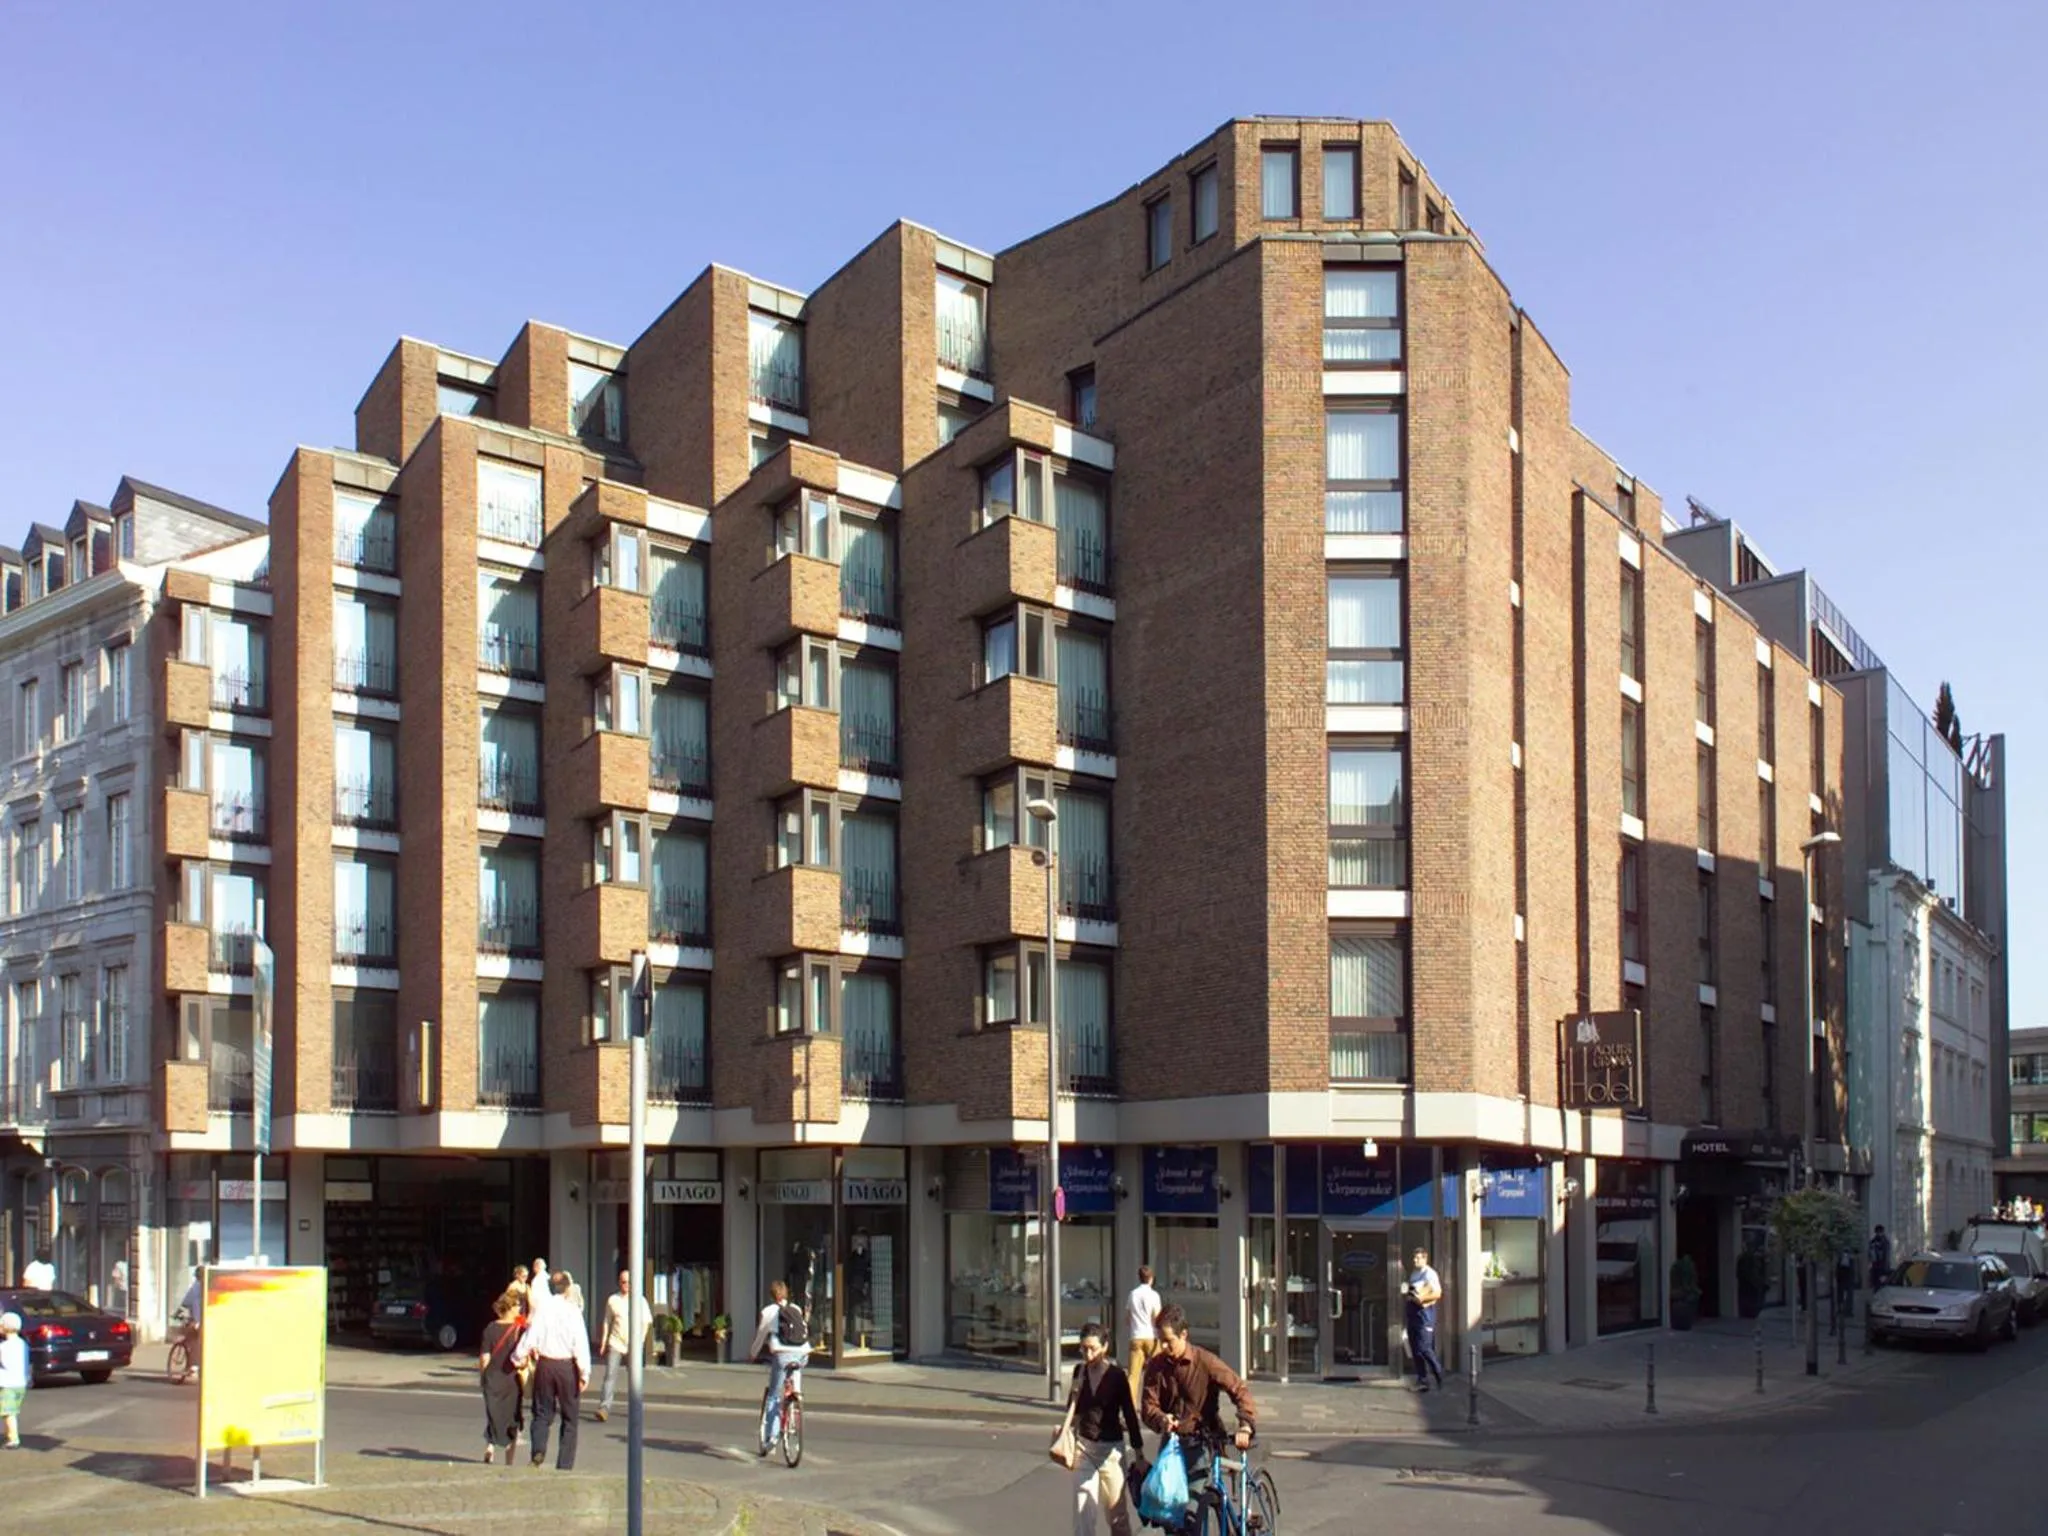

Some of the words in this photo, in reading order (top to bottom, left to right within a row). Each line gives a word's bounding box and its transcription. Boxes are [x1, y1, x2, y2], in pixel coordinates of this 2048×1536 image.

[1568, 1045, 1636, 1104] Hotel
[1692, 1142, 1730, 1154] HOTEL
[661, 1185, 716, 1200] IMAGO
[847, 1183, 902, 1200] IMAGO
